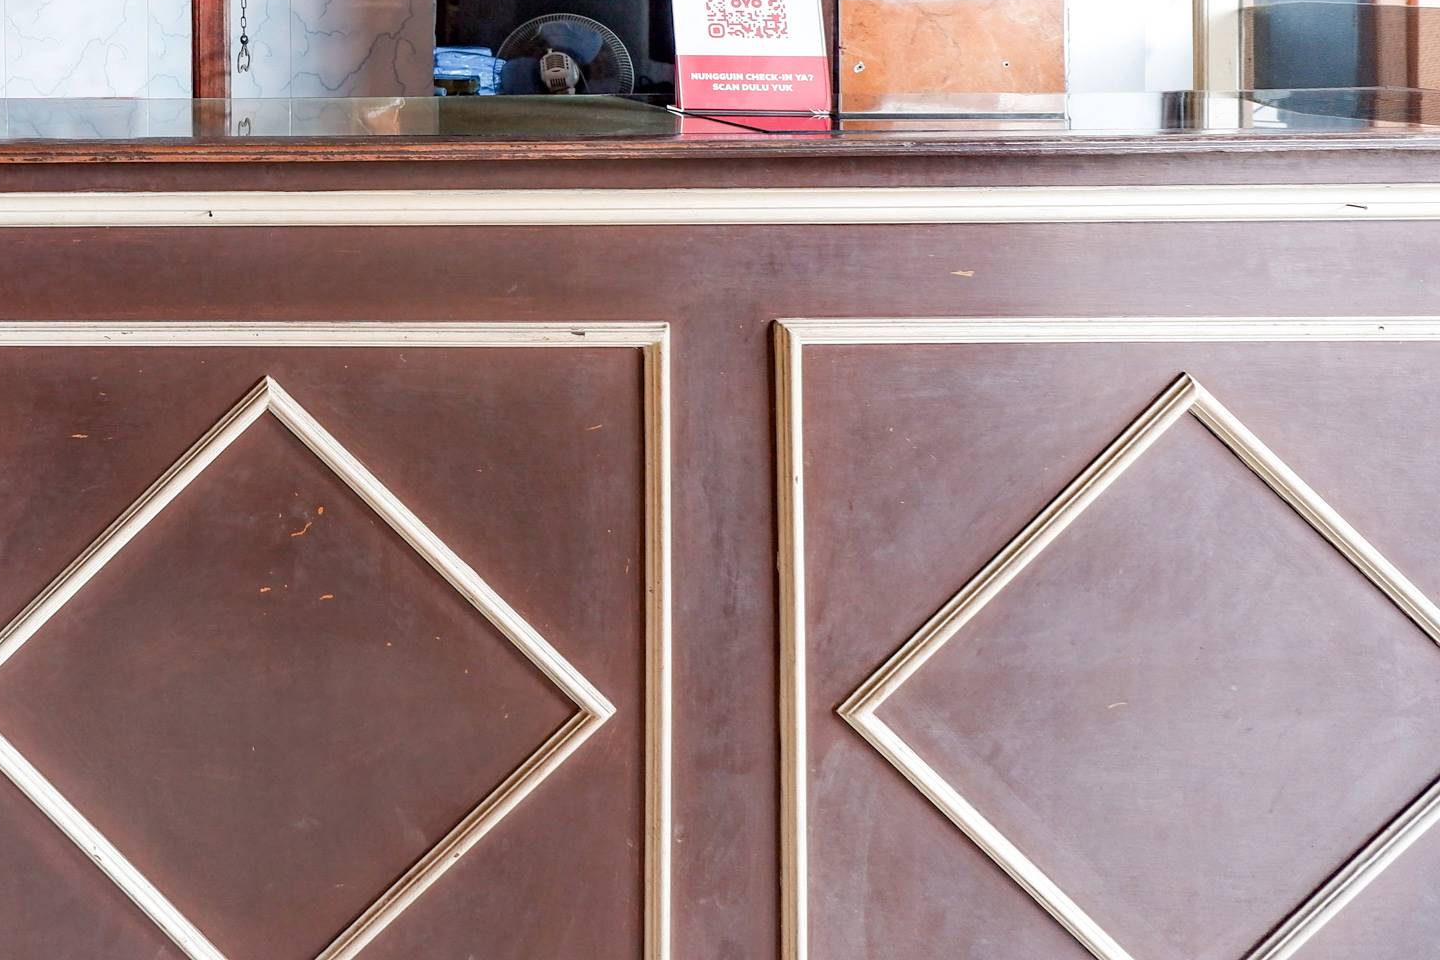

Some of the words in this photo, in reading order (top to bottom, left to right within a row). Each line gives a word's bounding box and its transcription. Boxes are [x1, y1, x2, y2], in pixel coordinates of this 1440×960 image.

[690, 72, 744, 81] NUNGGUIN
[745, 73, 793, 81] CHECK-IN
[795, 73, 814, 82] YA?
[712, 83, 740, 91] SCAN
[741, 83, 770, 91] DULU
[771, 84, 793, 92] YUK
